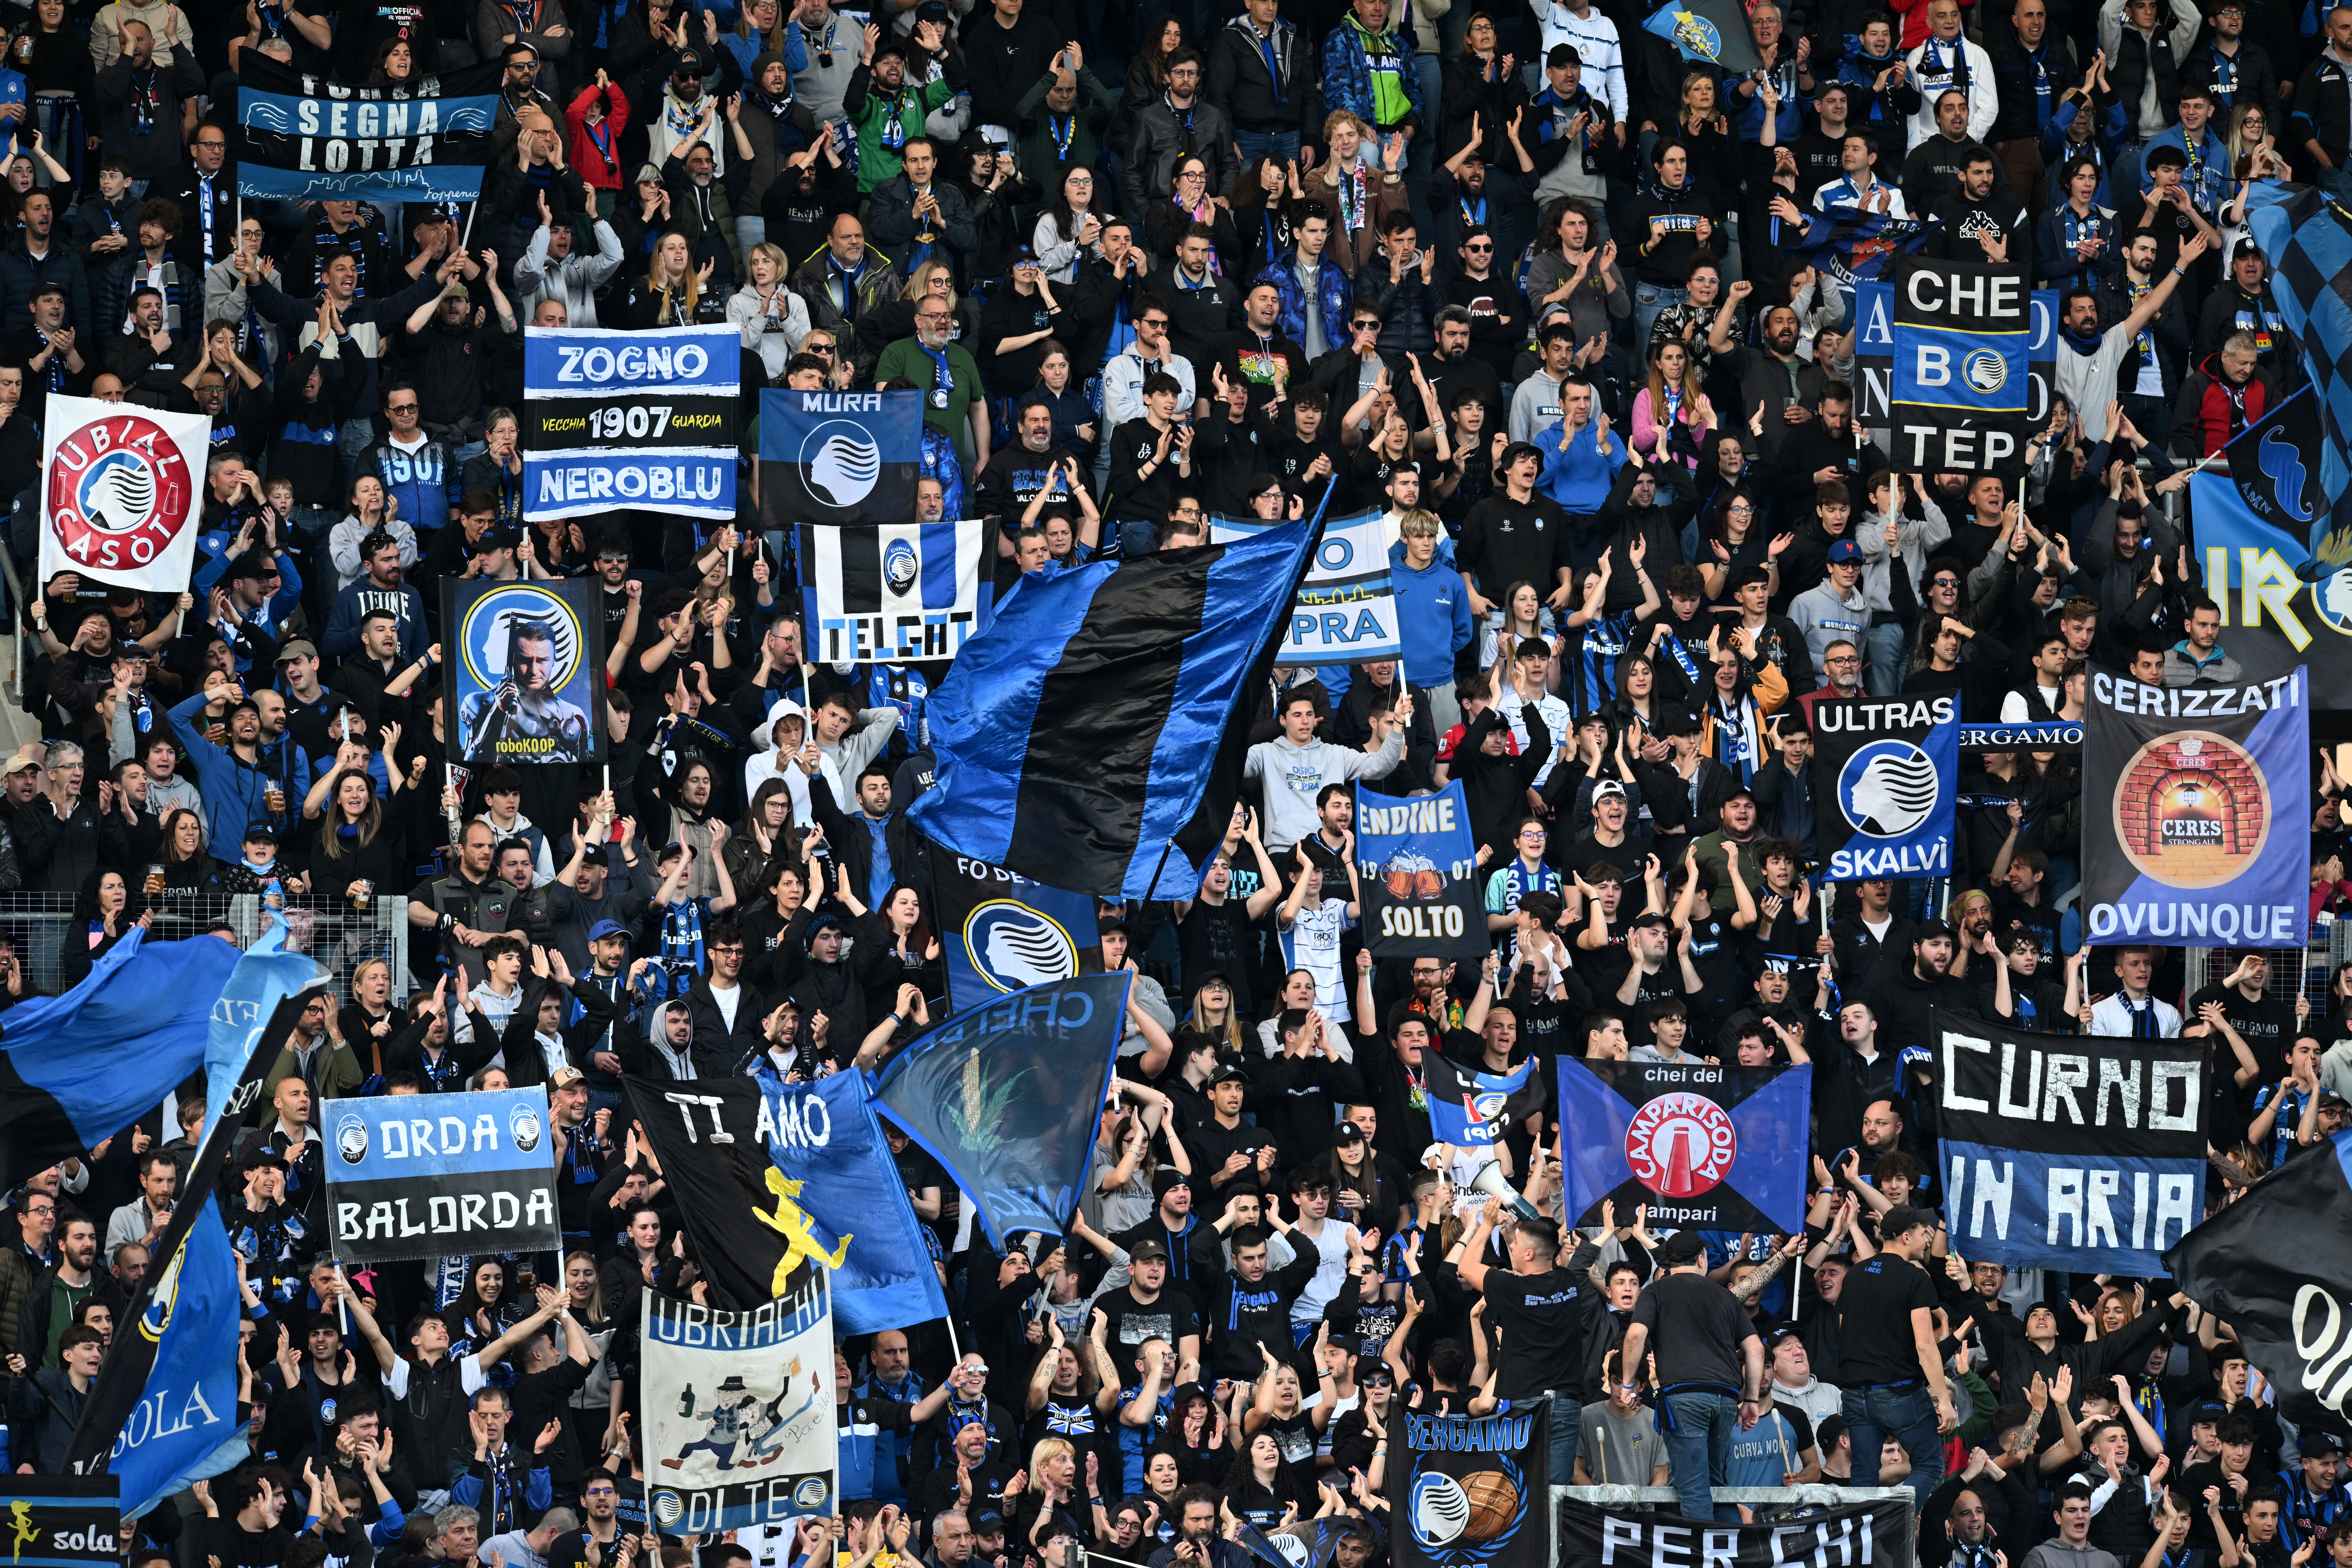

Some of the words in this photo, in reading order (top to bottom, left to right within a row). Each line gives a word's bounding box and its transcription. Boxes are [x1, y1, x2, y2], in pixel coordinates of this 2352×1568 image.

[299, 100, 438, 137] SEGNA
[300, 136, 432, 173] LOTTA
[1960, 231, 2000, 239] Kapa
[1907, 270, 2020, 317] CHE
[557, 343, 708, 382] ZOGNO
[802, 392, 881, 412] MURA
[542, 417, 586, 432] VECCHIA
[589, 406, 673, 438] 1907
[672, 414, 722, 430] GUARDIA
[56, 420, 181, 479] ÜBIAL
[1138, 451, 1152, 460] 07
[1903, 419, 2014, 471] TÉP
[539, 466, 722, 503] NEROBLU
[2241, 482, 2274, 514] AMN
[55, 507, 172, 566] CASÒT
[890, 545, 910, 555] CURVA
[822, 611, 973, 661] TELGAT
[1825, 621, 1859, 633] BERGAMO
[2094, 672, 2298, 717] CERIZZATI
[1819, 697, 1955, 732] ULTRAS
[496, 737, 555, 753] roboKOOP
[454, 767, 466, 777] BNA
[1293, 766, 1316, 775] OSIO
[2176, 758, 2206, 768] CERES
[1361, 798, 1456, 835] ENDINE
[2162, 819, 2221, 836] CERES
[957, 857, 987, 879] FO
[994, 866, 1025, 884] DE
[1361, 859, 1377, 880] 19
[1452, 858, 1472, 881] 07
[1830, 836, 1947, 877] SKALVÌ
[1381, 905, 1464, 936] SOLTO
[2089, 903, 2294, 945] OVUNQUE
[1644, 1067, 1686, 1083] chei
[1693, 1067, 1723, 1083] del
[1942, 1031, 2201, 1132] CURNO
[339, 1119, 363, 1129] ATALANTA
[664, 1092, 735, 1144] TI
[754, 1092, 831, 1149] AMO
[1463, 1113, 1511, 1141] 1907
[338, 1188, 553, 1240] BALORDA
[1634, 1206, 1717, 1223] campari
[1949, 1155, 2013, 1240] IN
[2047, 1167, 2194, 1251] ARIA
[659, 1272, 819, 1348] UBRIACHI
[1405, 1413, 1533, 1453] BERGAMO
[1734, 1441, 1763, 1460] CURVA
[688, 1488, 724, 1532] DI
[741, 1477, 789, 1523] TE
[54, 1524, 117, 1552] sola
[1602, 1515, 1739, 1568] PER
[1771, 1514, 1873, 1568] CHI
